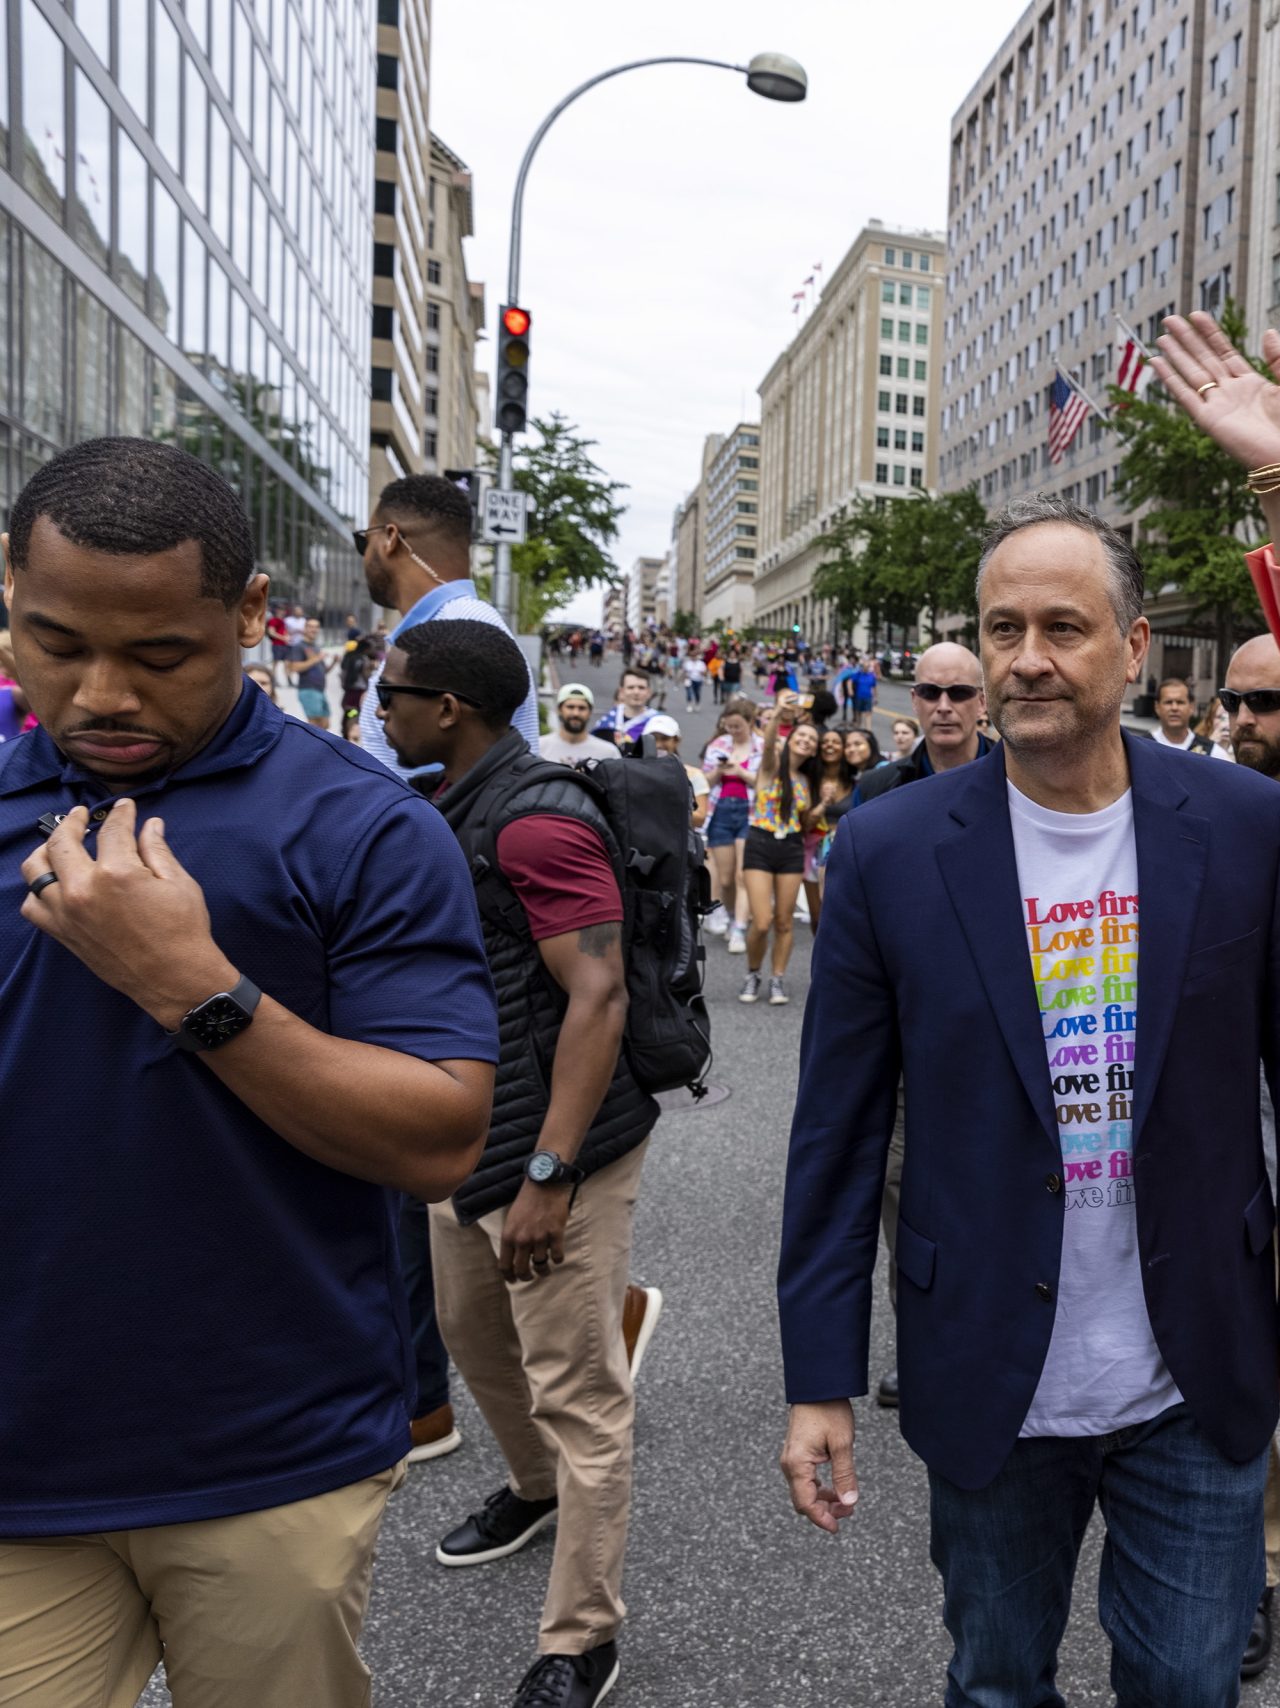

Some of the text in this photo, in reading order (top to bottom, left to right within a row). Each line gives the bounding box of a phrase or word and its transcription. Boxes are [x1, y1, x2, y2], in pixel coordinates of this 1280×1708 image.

[488, 493, 520, 507] ONE
[488, 508, 520, 521] WAY
[1024, 898, 1095, 925] Love
[1028, 926, 1095, 953] Love
[1032, 946, 1137, 982] Love fir
[1036, 975, 1137, 1011] Love fir
[1049, 1044, 1099, 1067] ove
[1052, 1073, 1100, 1095] ove
[1108, 1122, 1133, 1150] fi
